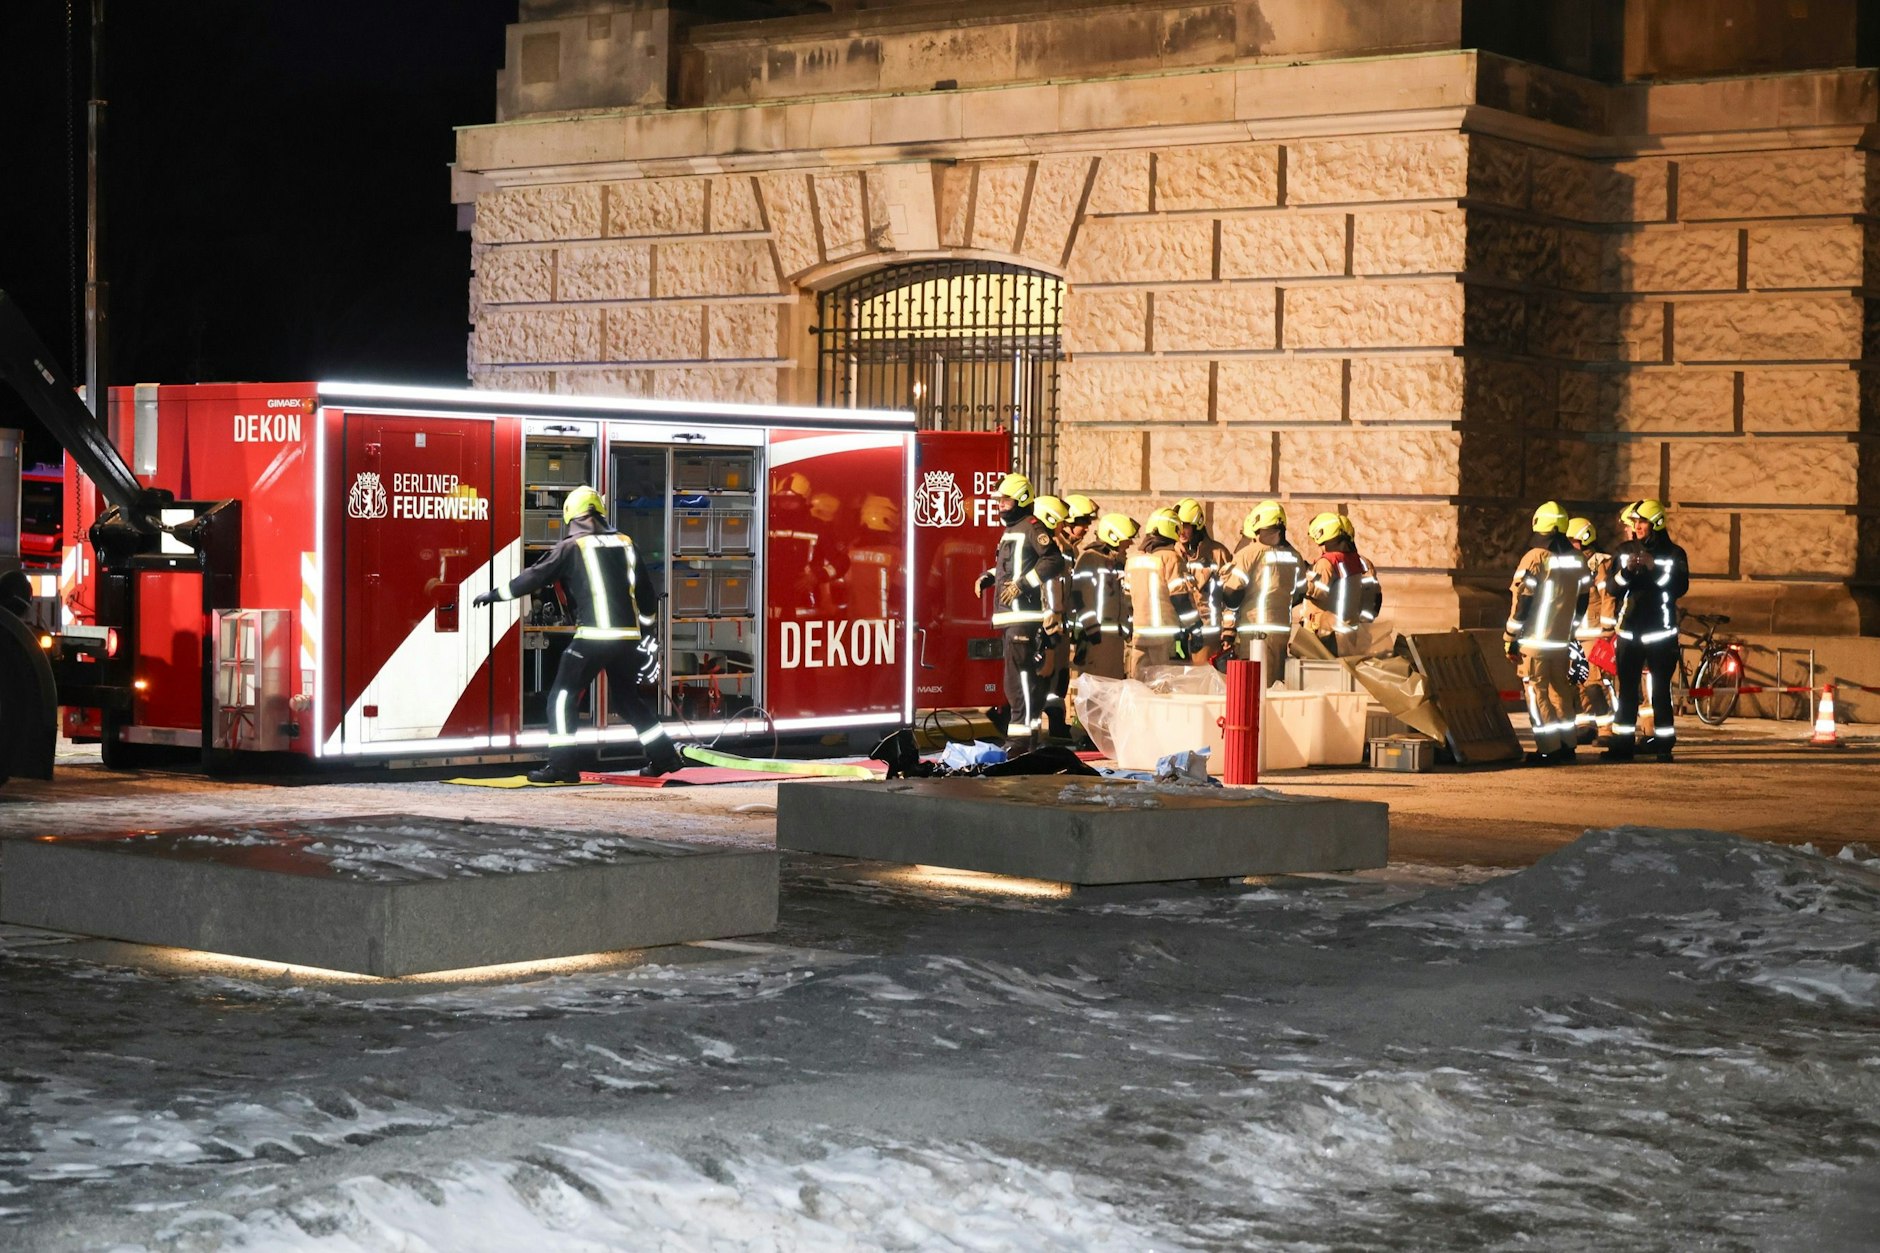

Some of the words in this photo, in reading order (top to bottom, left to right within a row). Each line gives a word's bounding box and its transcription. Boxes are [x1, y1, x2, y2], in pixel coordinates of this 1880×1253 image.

[267, 399, 301, 408] GIMAEX
[234, 414, 301, 443] DEKON
[393, 473, 459, 494] BERLINER
[393, 496, 489, 521] FEUERWEHR
[973, 499, 1006, 527] FE
[780, 618, 896, 669] DEKON
[917, 685, 943, 693] MAEX
